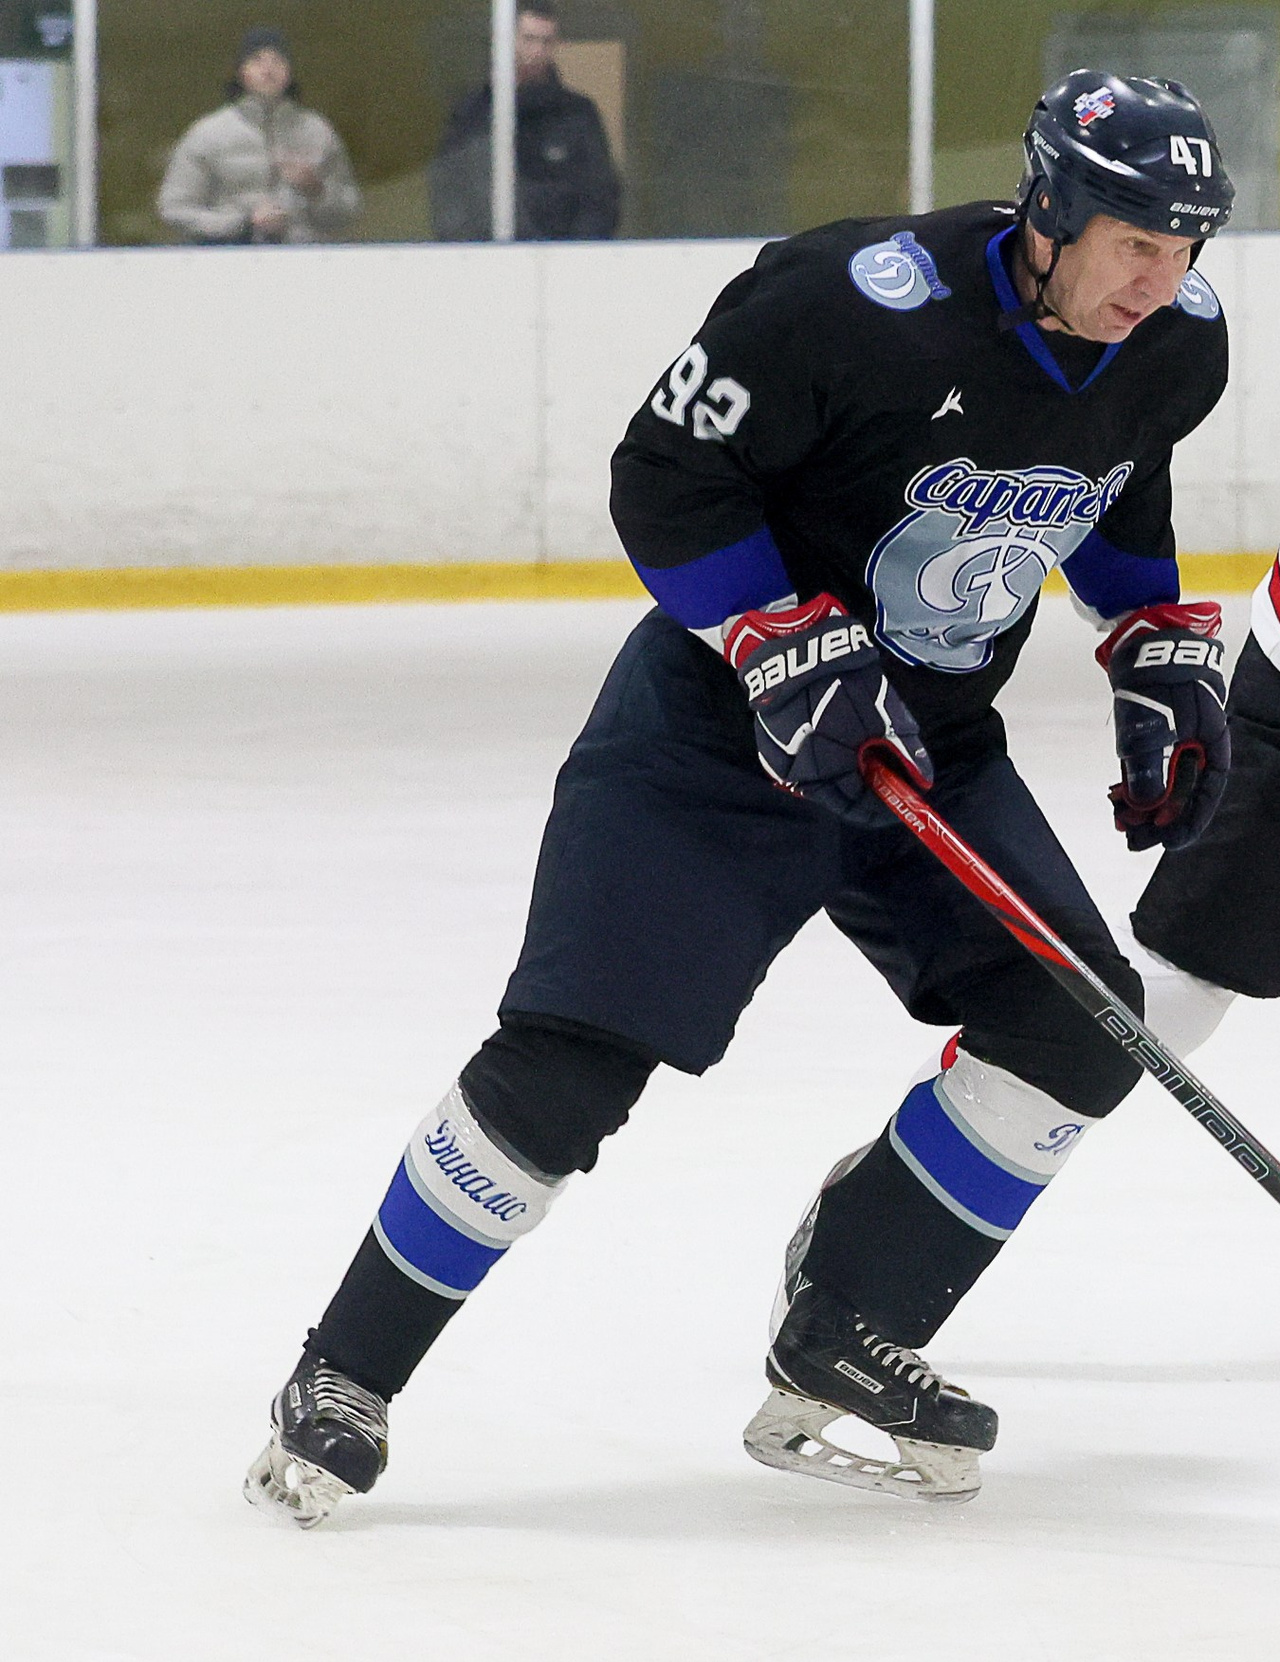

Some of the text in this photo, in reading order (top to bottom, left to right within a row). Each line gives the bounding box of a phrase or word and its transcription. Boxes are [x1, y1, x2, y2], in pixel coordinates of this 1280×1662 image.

[1170, 135, 1212, 178] 47
[1170, 202, 1220, 218] BAUER
[650, 342, 751, 442] 92
[744, 624, 874, 702] BAUER
